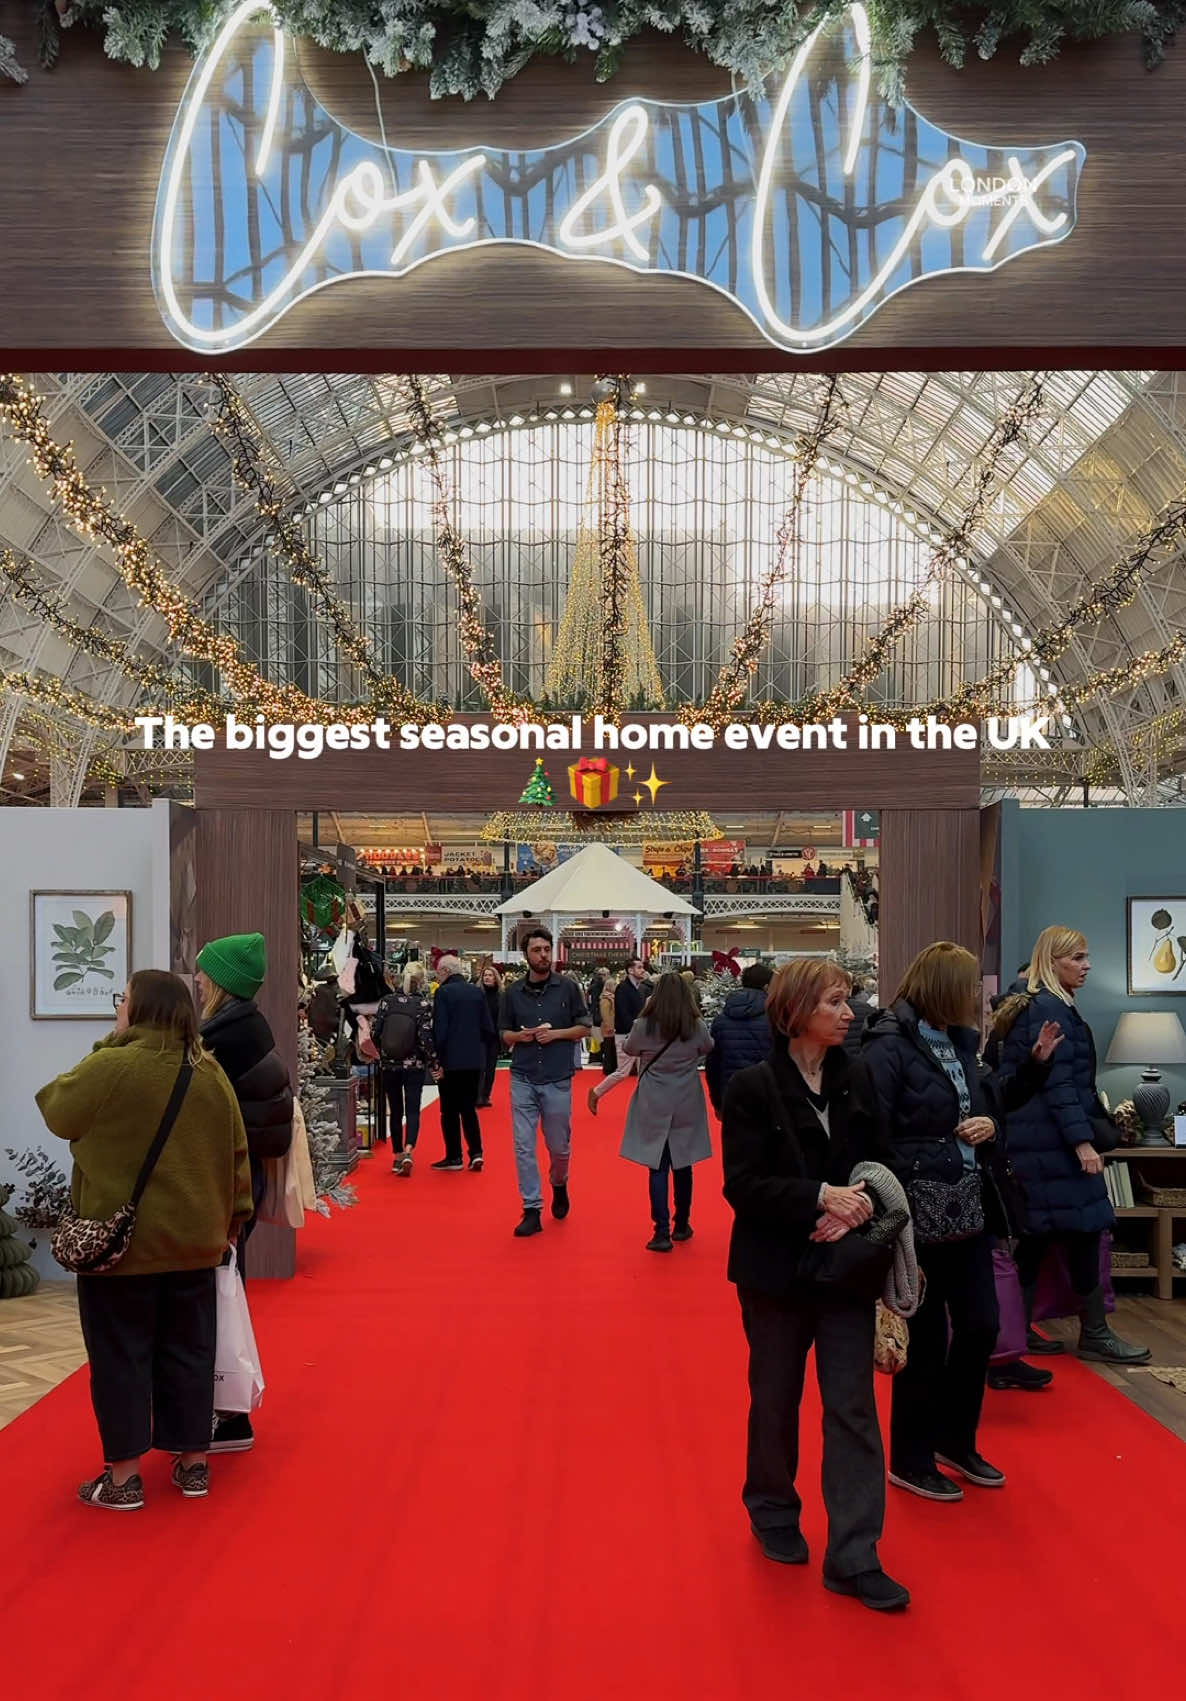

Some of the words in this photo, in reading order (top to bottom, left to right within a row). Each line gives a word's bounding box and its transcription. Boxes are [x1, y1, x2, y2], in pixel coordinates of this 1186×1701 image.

[160, 0, 487, 342] Cox
[559, 105, 661, 261] &
[752, 2, 1076, 342] Cox
[212, 1374, 225, 1382] OX
